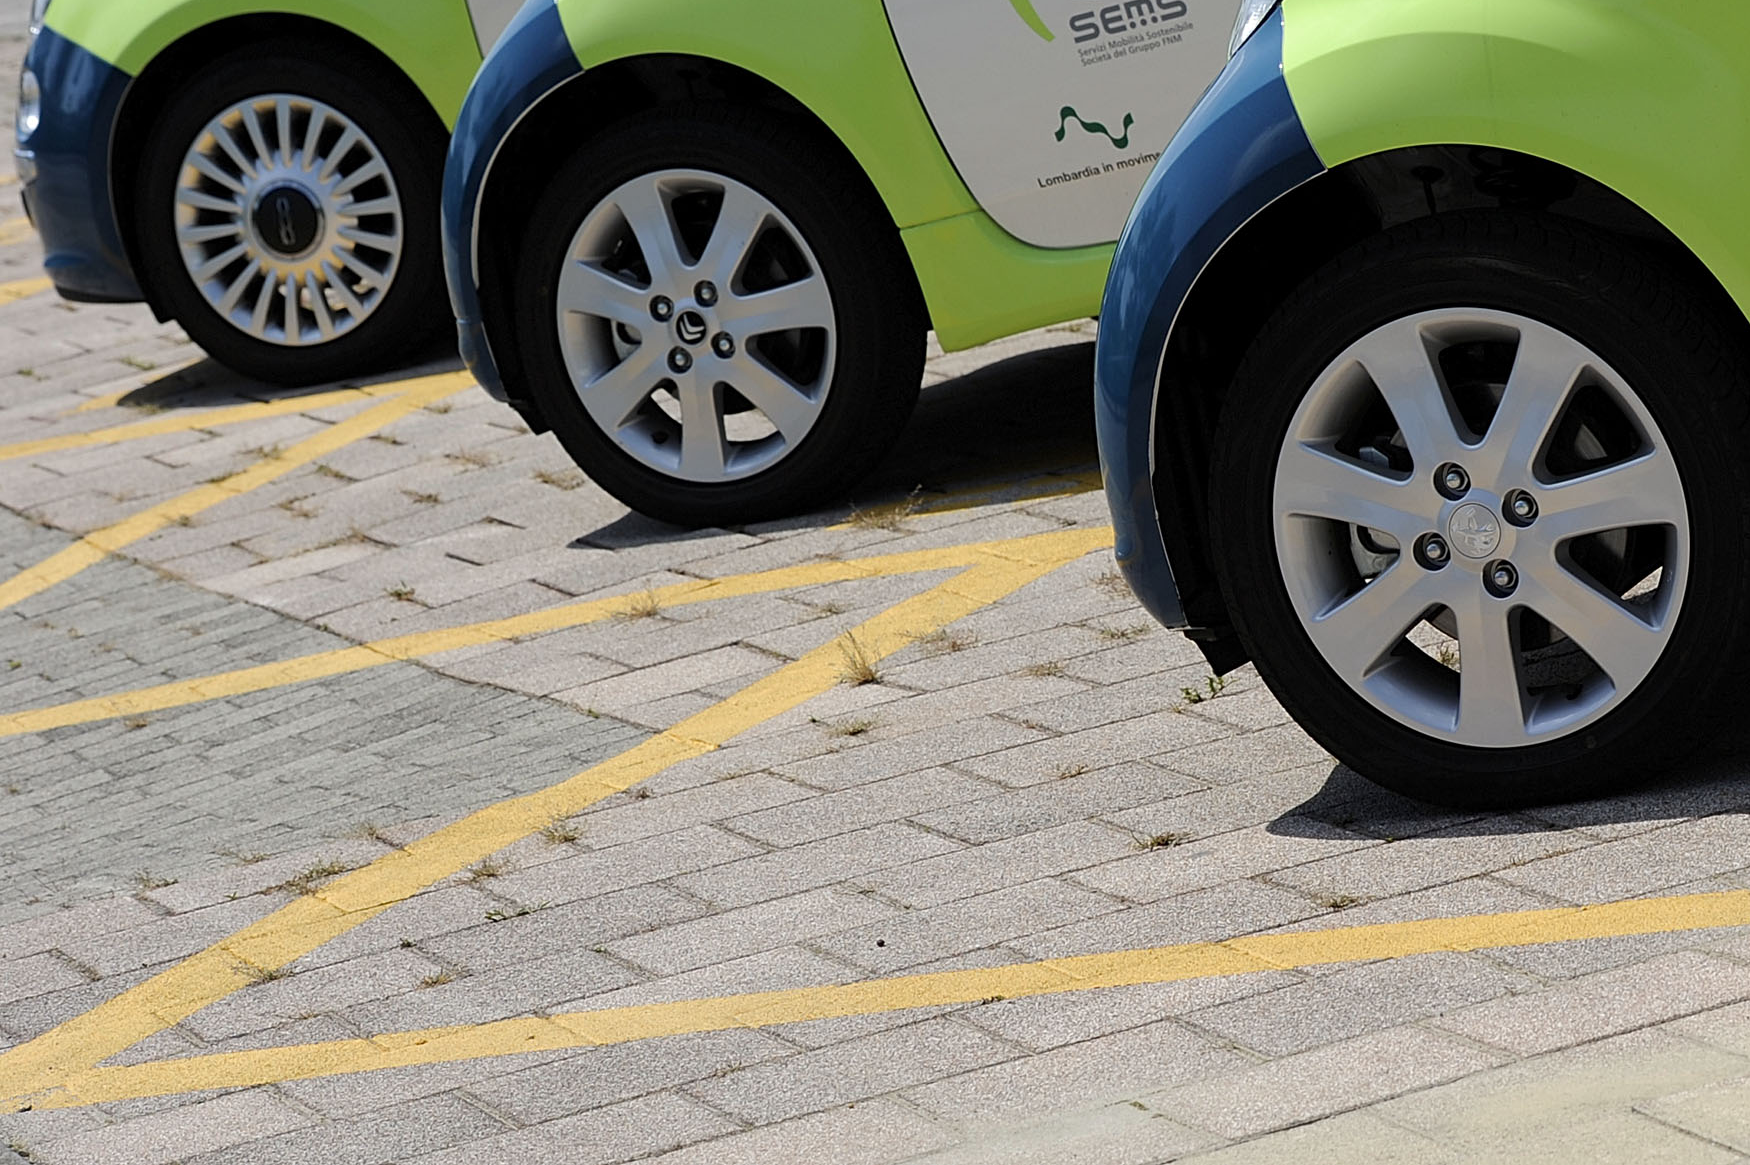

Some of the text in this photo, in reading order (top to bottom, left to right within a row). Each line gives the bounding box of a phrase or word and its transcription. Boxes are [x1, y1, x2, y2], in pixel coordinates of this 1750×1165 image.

[1128, 39, 1162, 55] Gruppo
[1037, 165, 1101, 188] Lombardia
[1102, 161, 1114, 173] in
